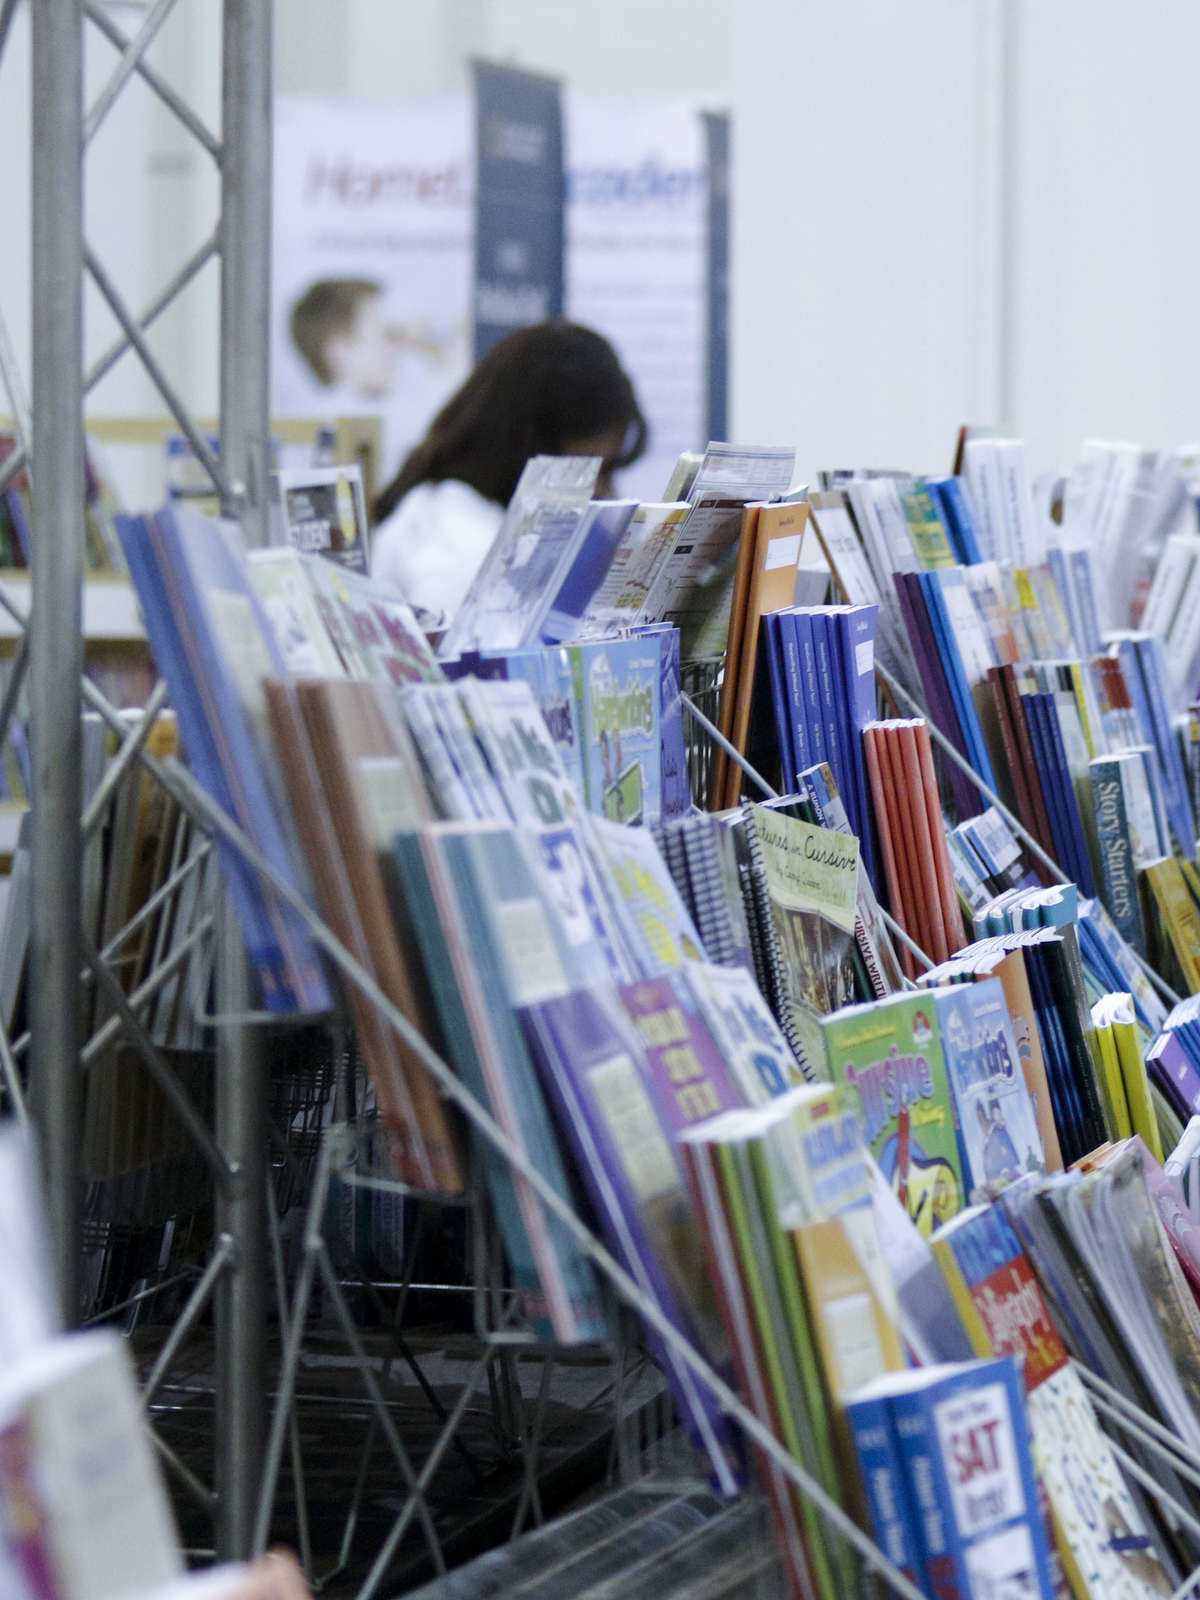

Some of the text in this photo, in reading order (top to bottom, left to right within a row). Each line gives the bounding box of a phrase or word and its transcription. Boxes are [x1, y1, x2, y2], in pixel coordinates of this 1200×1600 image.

[809, 791, 826, 821] KUMON
[804, 835, 856, 871] Cursive
[1098, 781, 1131, 918] Story Starters
[867, 962, 887, 999] WRITI
[951, 1419, 1000, 1484] SAT
